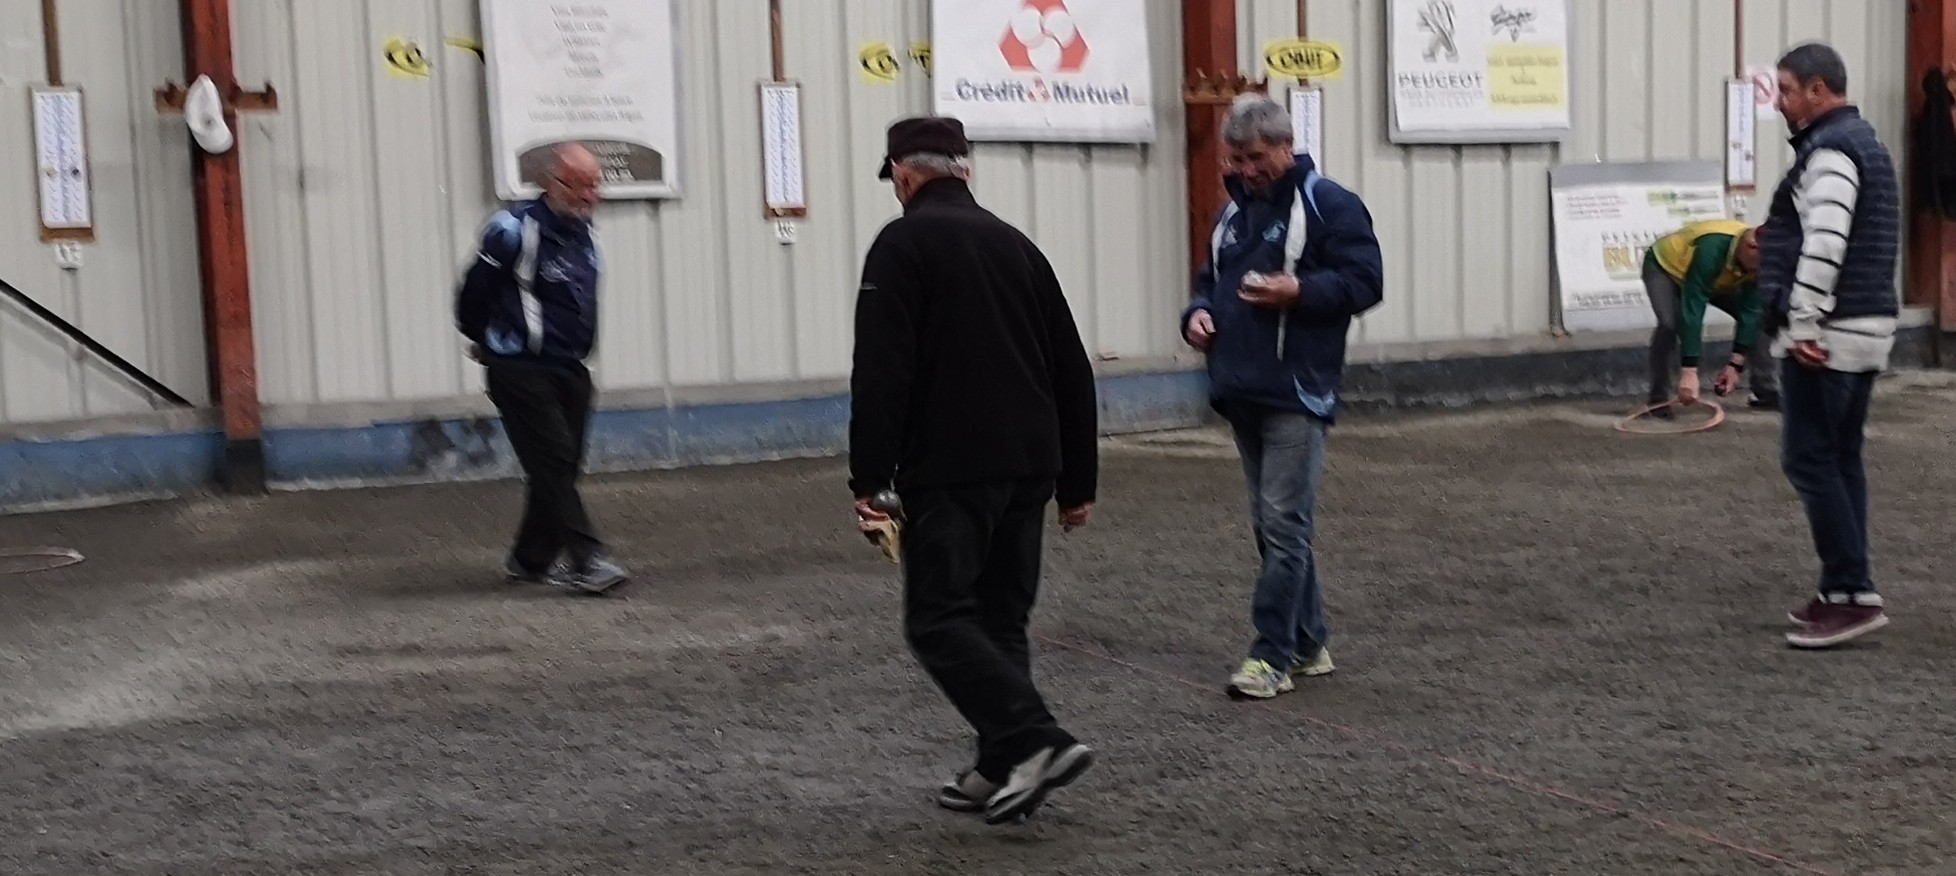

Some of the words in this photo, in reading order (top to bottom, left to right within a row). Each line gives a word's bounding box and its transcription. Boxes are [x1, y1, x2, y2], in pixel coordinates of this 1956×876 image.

[1398, 71, 1483, 89] PEUGEOT
[956, 79, 1025, 102] Crédit
[1053, 81, 1129, 104] Mutuel
